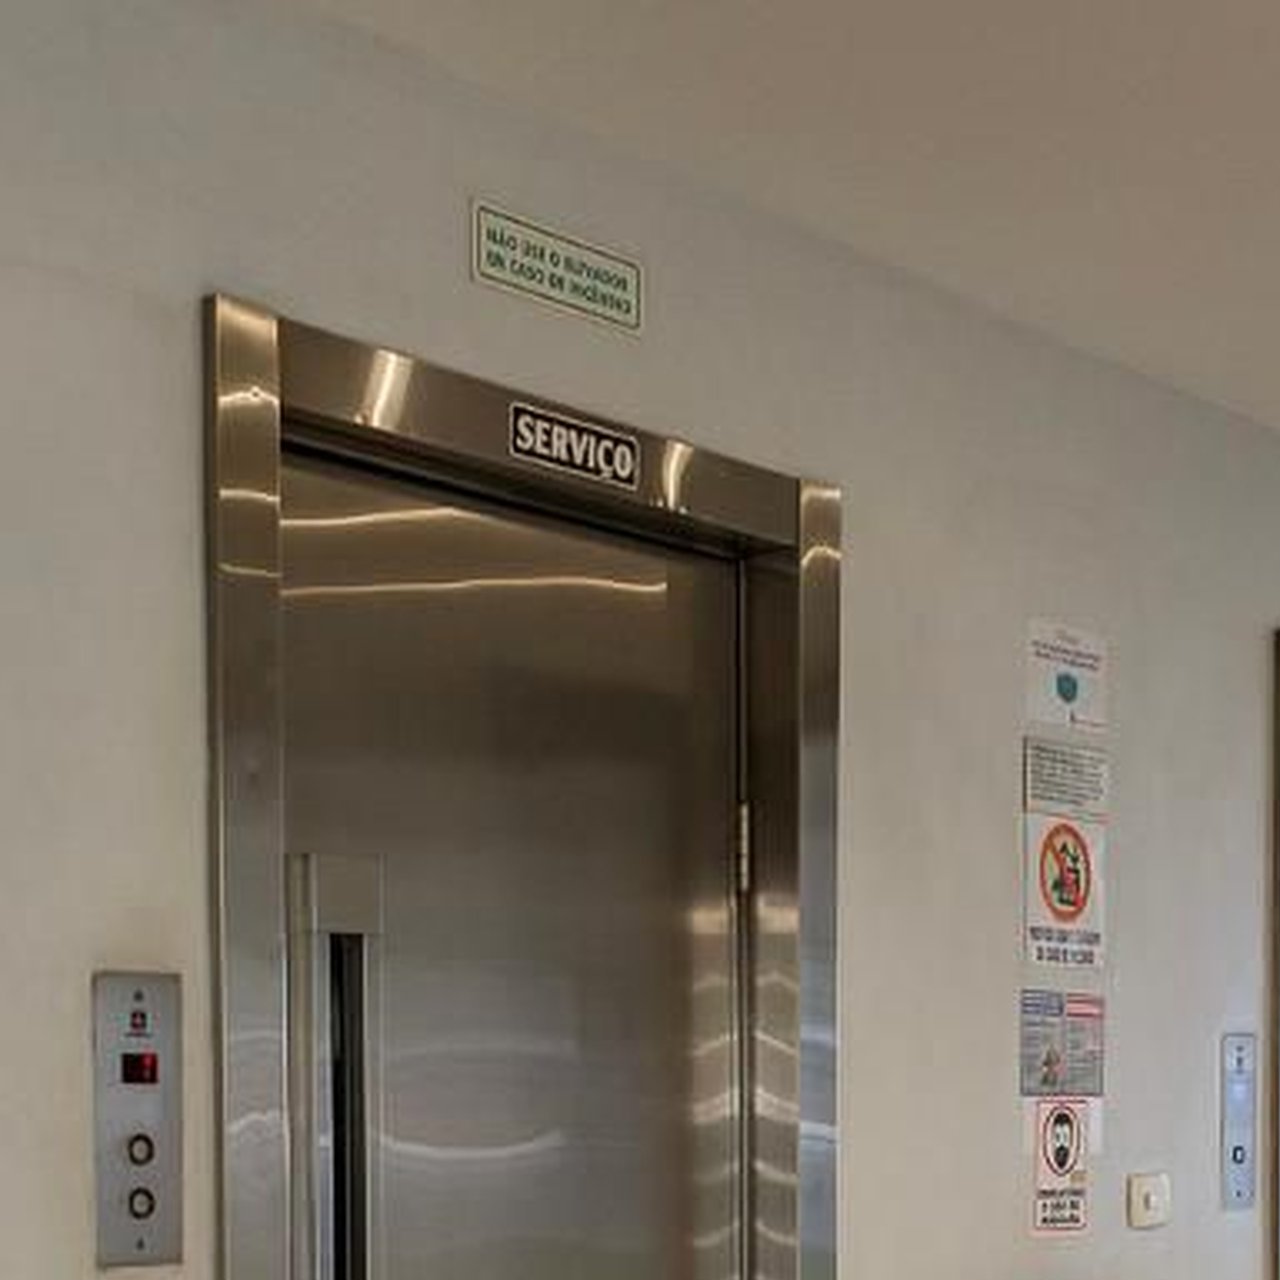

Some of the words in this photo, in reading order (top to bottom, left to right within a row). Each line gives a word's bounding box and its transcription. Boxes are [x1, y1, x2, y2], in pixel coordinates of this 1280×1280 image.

[510, 259, 545, 285] CASO
[549, 251, 561, 268] O
[516, 413, 632, 479] SERVIÇO
